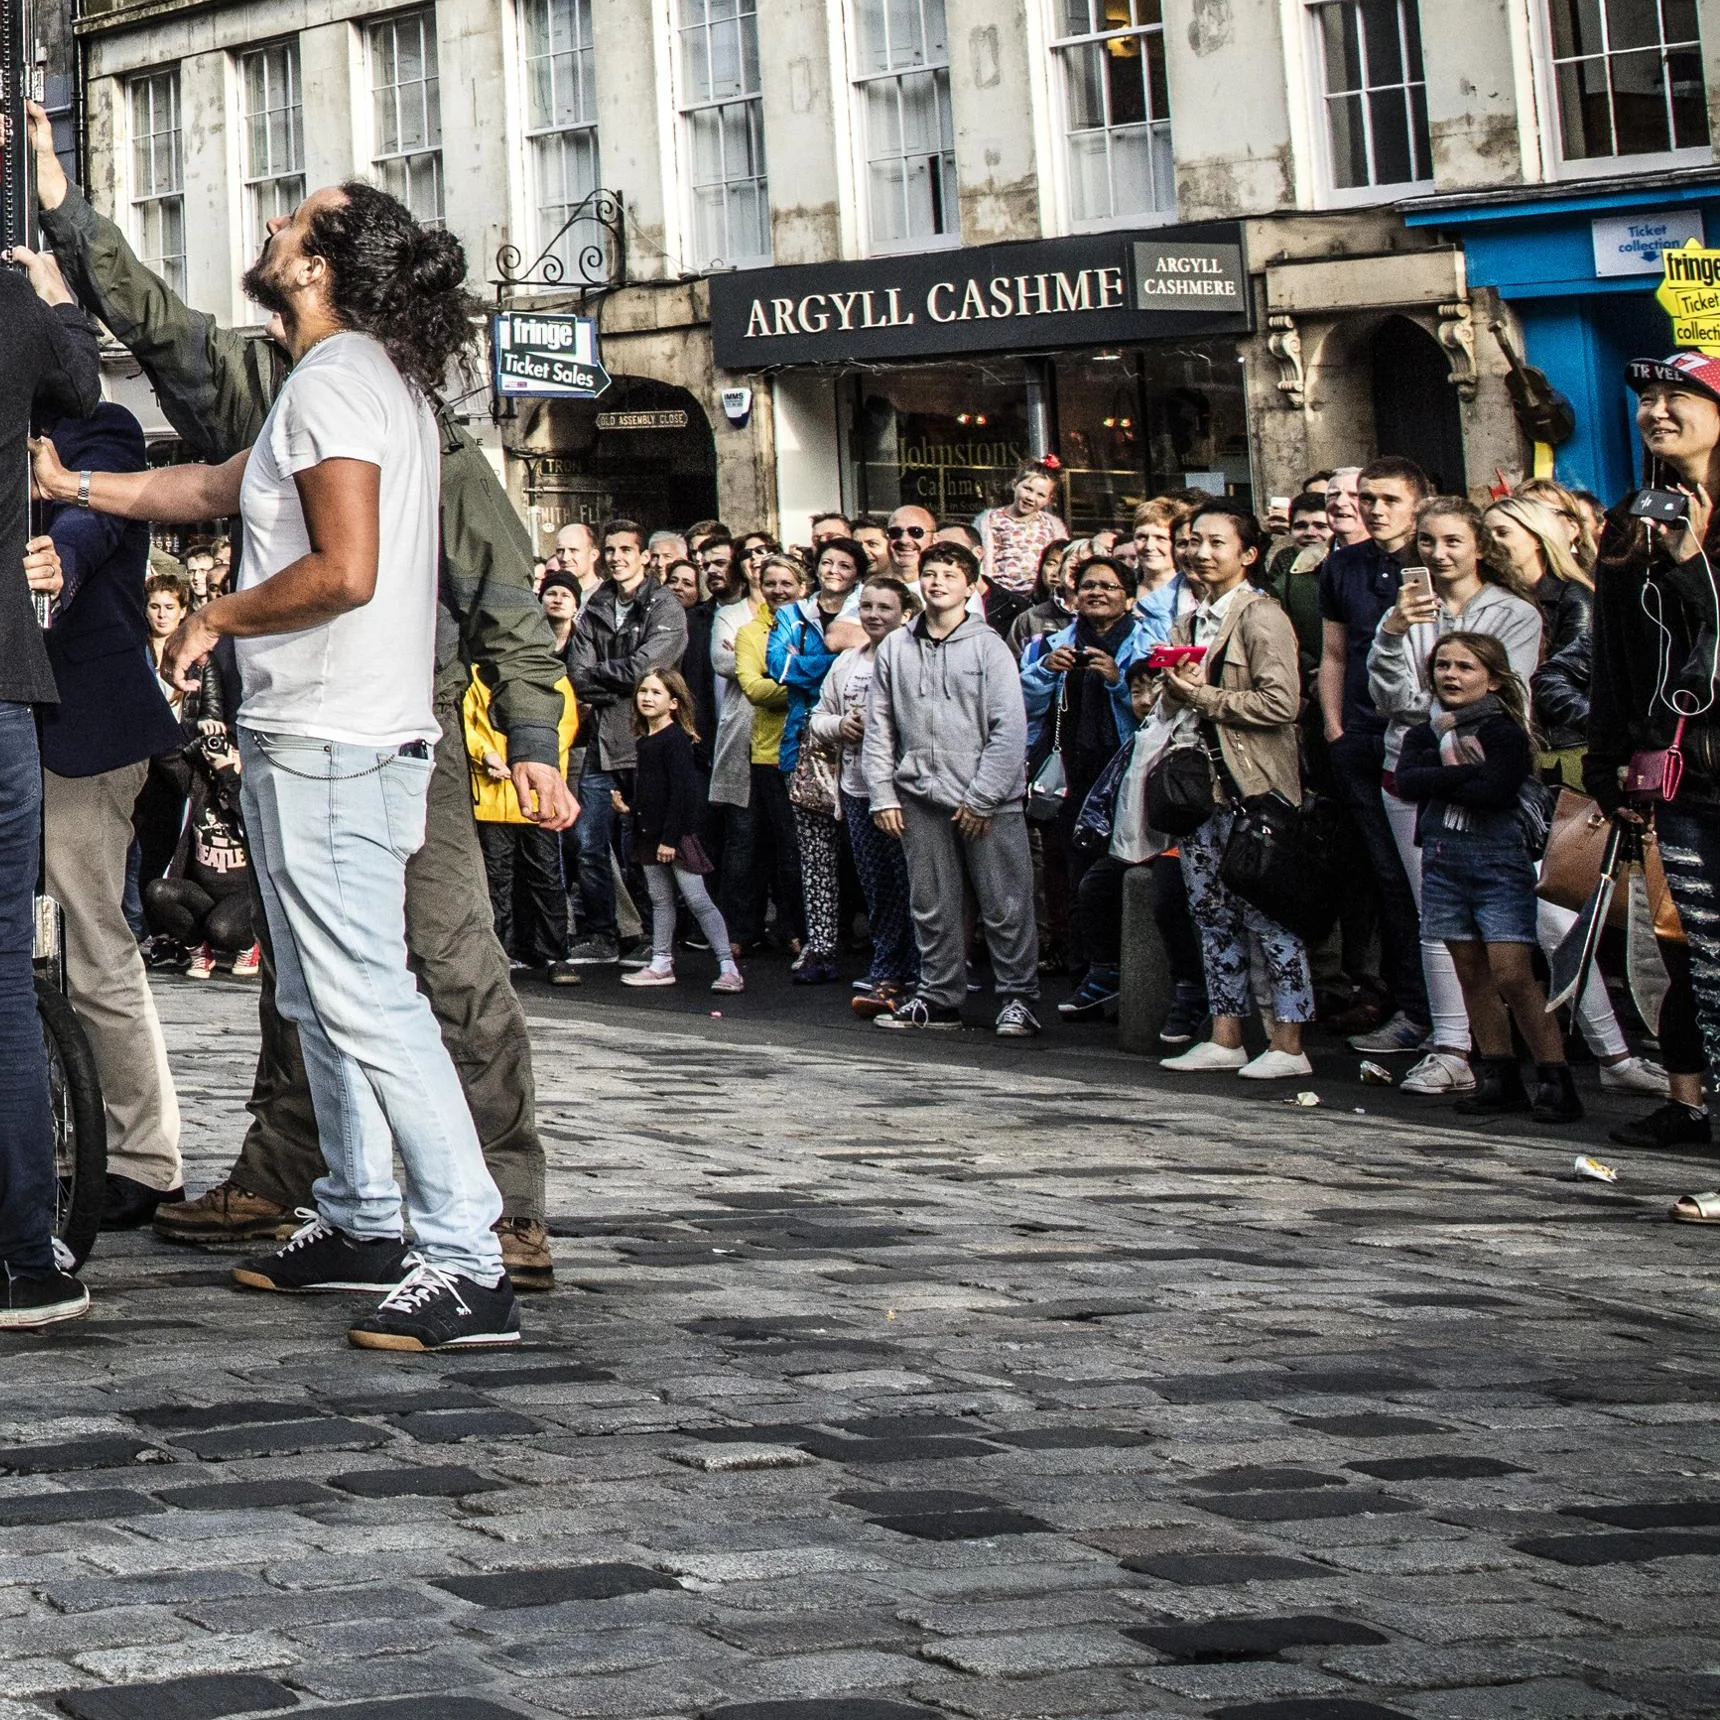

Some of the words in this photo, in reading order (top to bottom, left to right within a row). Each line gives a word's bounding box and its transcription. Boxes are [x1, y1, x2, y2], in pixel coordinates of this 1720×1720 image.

[1628, 224, 1667, 238] Ticket
[1618, 238, 1680, 253] collection
[1155, 256, 1223, 273] ARGYLL
[1143, 278, 1236, 295] CASHMERE
[743, 287, 915, 338] ARGYLL
[926, 267, 1125, 324] CASHME
[1681, 292, 1720, 314] Ticket
[513, 317, 573, 351] fringe
[1677, 321, 1720, 341] collecti
[504, 352, 550, 379] Ticket
[552, 362, 595, 388] Sales
[600, 415, 616, 426] OLD
[618, 414, 656, 426] ASSEMBLY
[659, 413, 684, 425] CLOSE
[898, 436, 1022, 480] Johnstons
